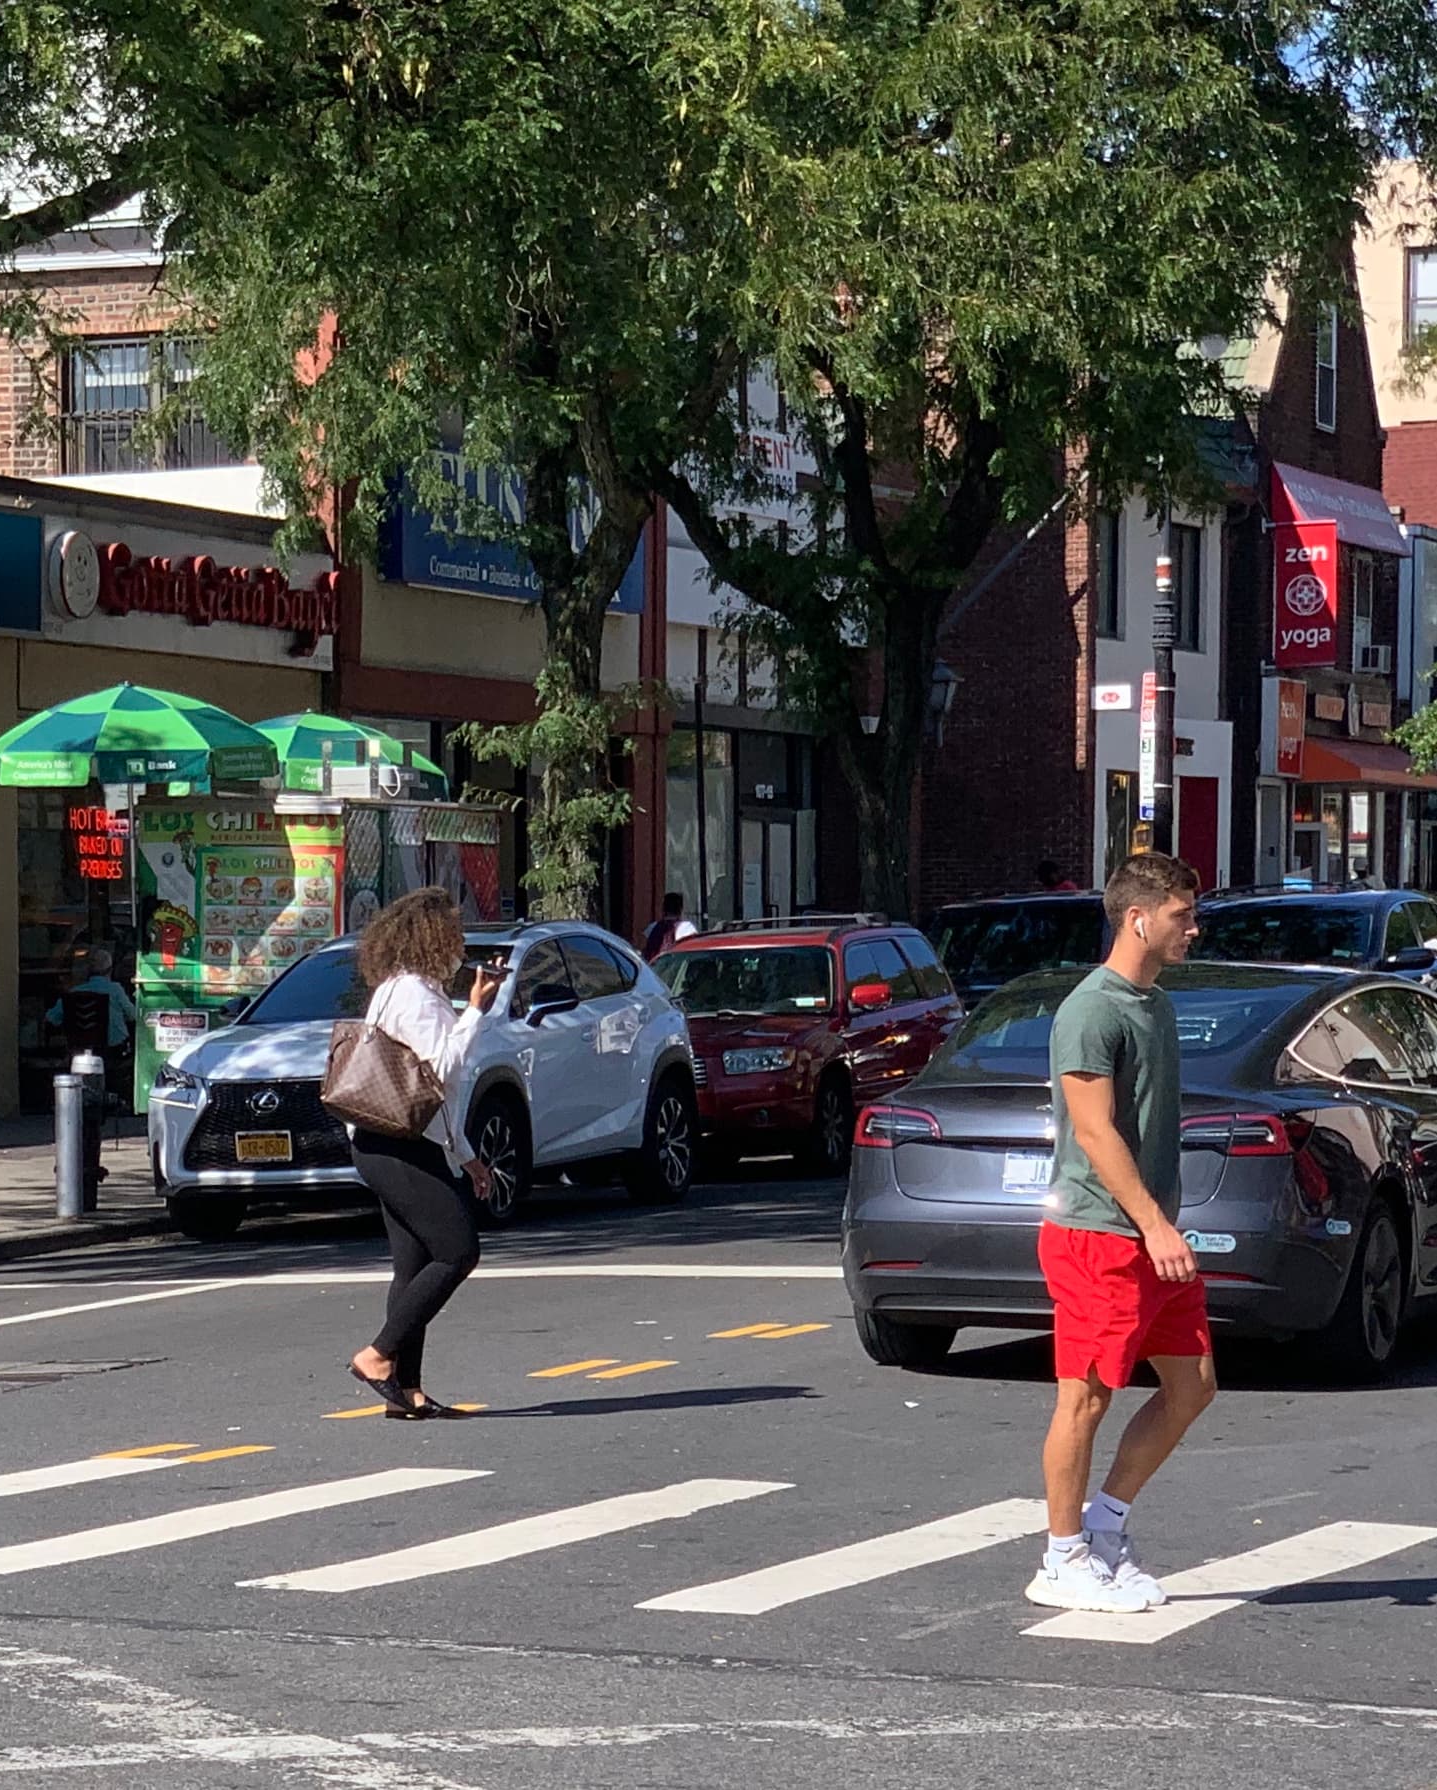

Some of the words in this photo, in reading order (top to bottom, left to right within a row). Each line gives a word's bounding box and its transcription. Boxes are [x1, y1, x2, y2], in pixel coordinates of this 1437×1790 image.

[1285, 544, 1328, 564] zen
[429, 554, 481, 582] Commercial
[1279, 626, 1331, 650] yoga
[148, 760, 177, 771] Bank
[69, 808, 92, 831] HOT
[143, 811, 195, 833] LOS
[205, 811, 340, 833] CHILITOS
[164, 1015, 200, 1026] DANGER
